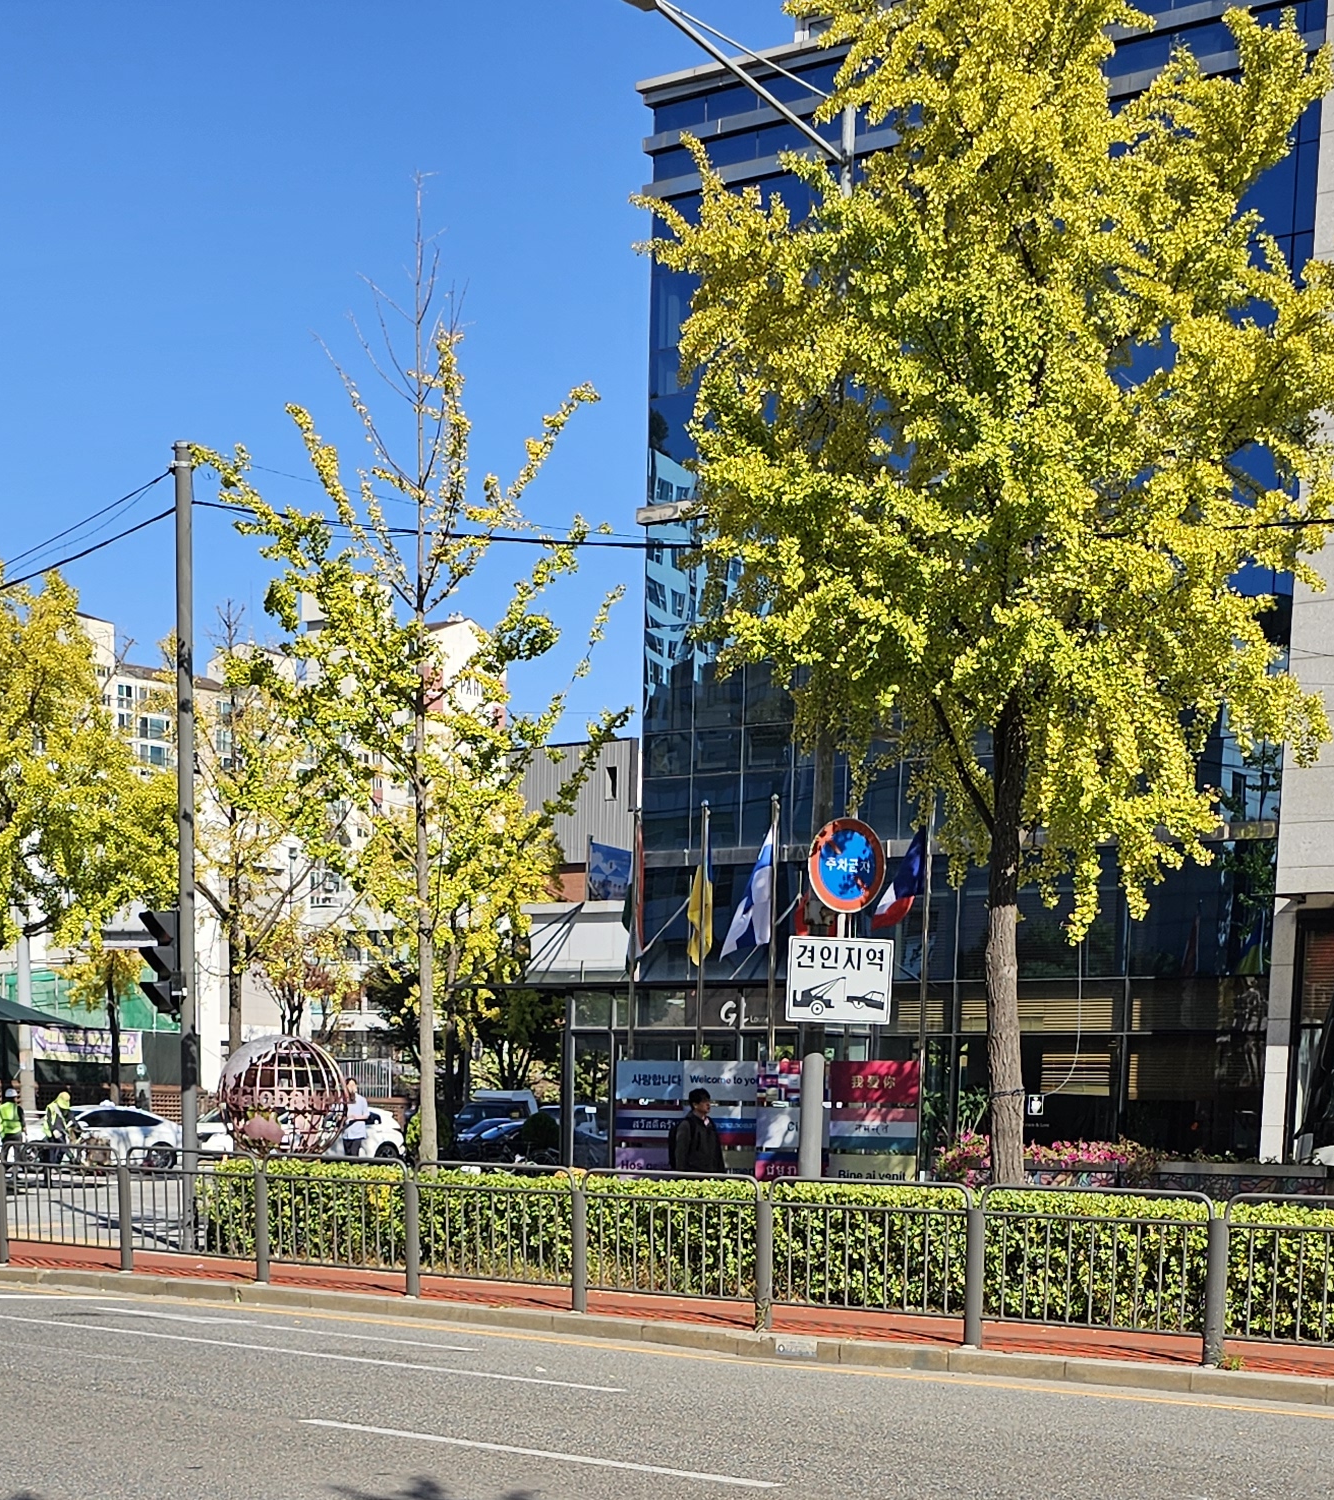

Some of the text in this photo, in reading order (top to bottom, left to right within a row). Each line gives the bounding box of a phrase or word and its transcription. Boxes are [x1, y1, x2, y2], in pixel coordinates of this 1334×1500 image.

[825, 857, 870, 874] 주차금지
[796, 945, 884, 972] 견인지역
[632, 1073, 681, 1087] 사랑합니다
[690, 1074, 731, 1084] Welcome
[734, 1074, 743, 1085] to
